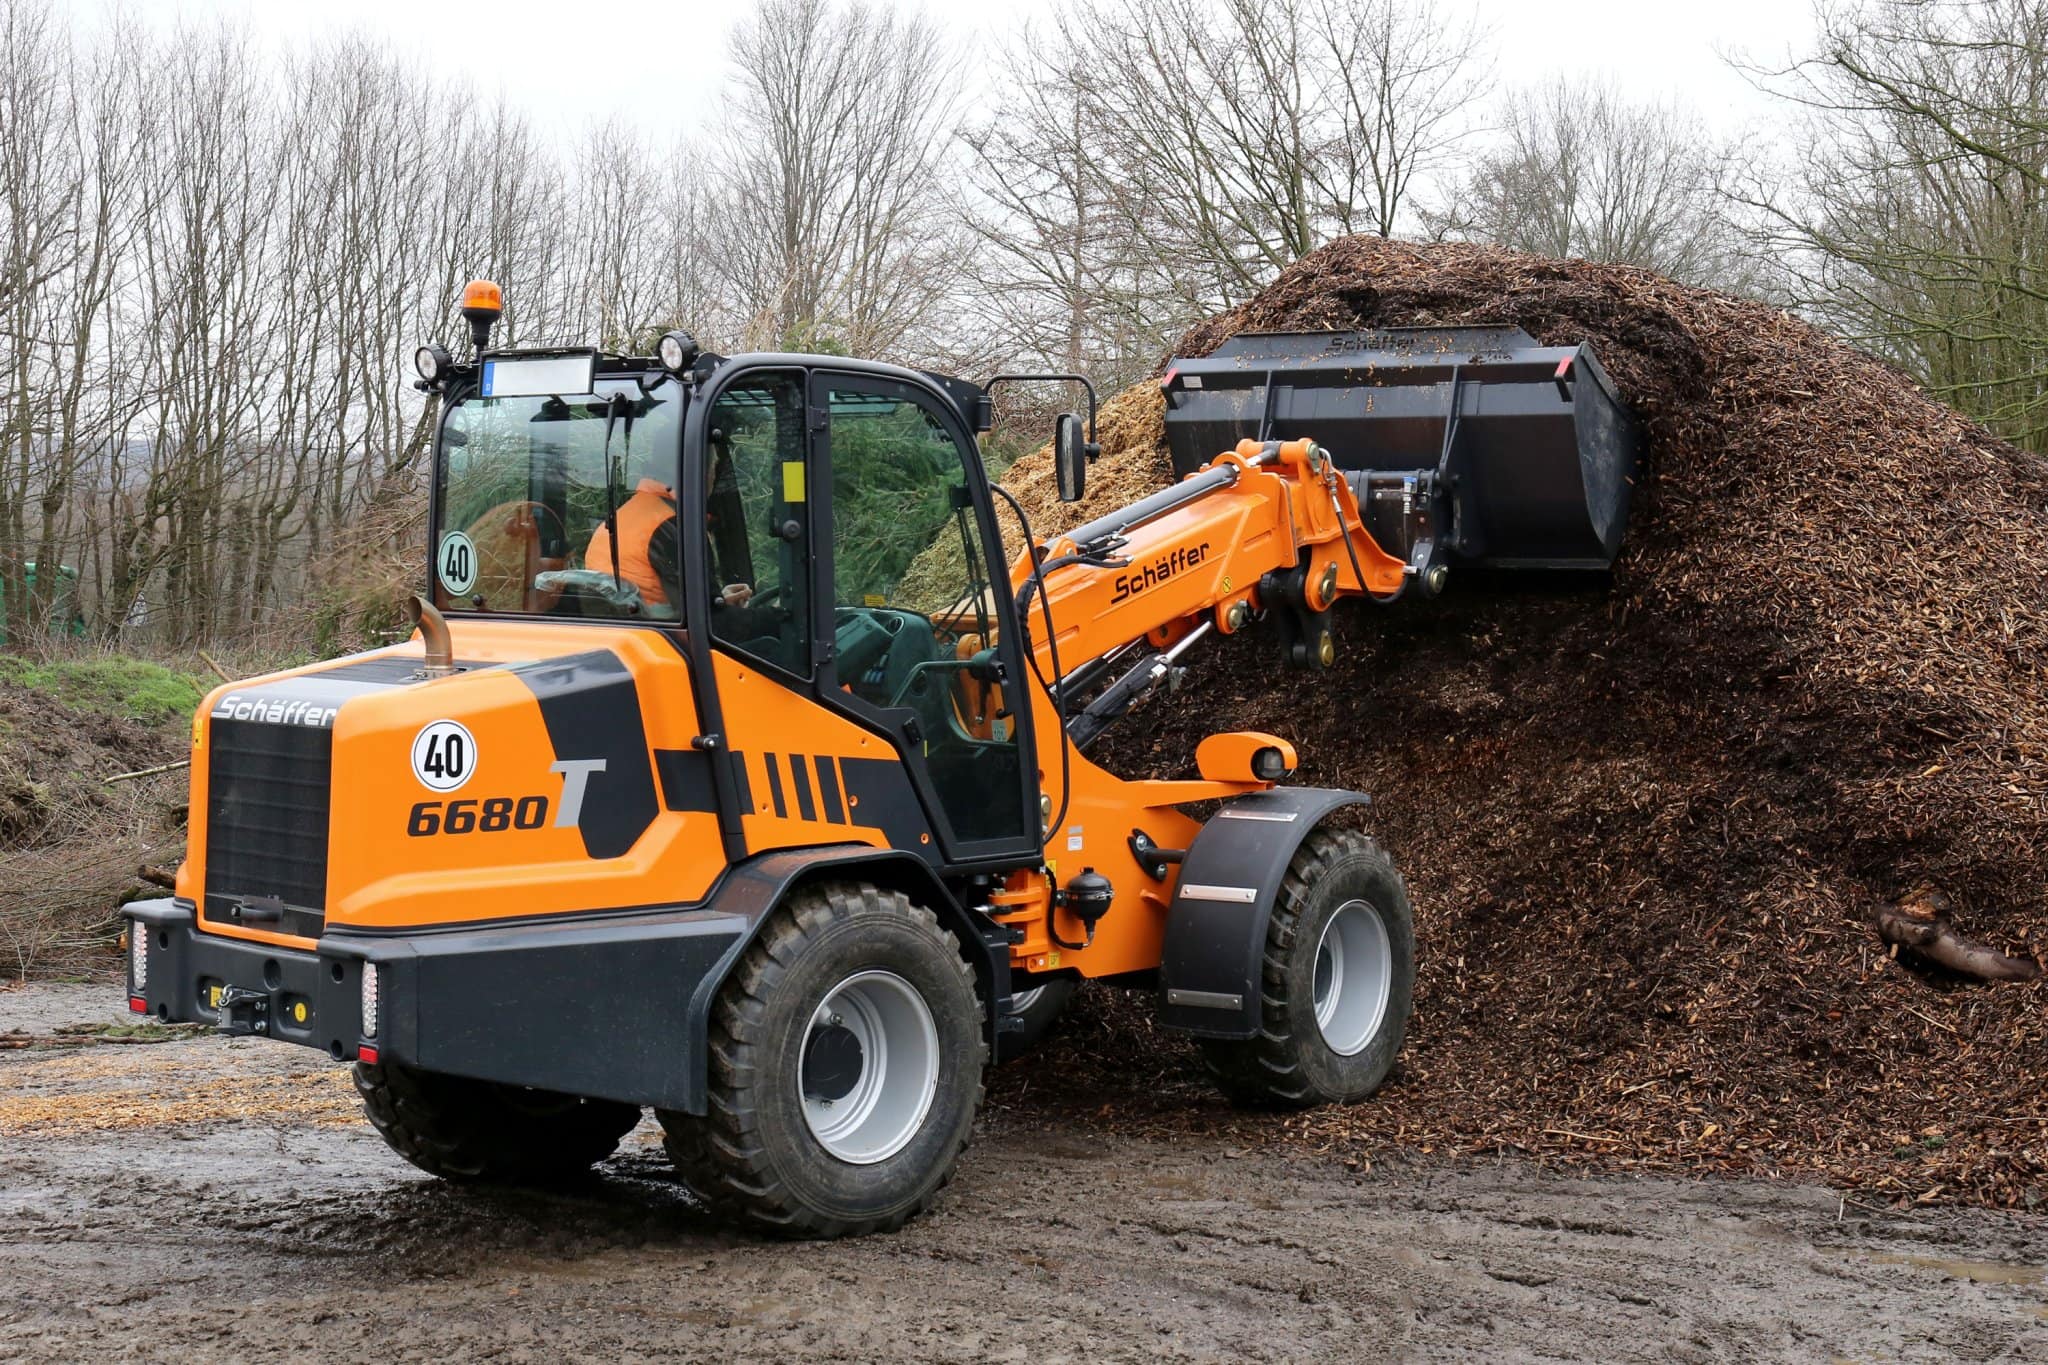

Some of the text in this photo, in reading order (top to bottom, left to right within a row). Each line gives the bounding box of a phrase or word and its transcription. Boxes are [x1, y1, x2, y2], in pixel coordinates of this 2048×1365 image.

[446, 544, 468, 582] 40
[1111, 542, 1210, 605] Schäffer
[210, 695, 337, 726] Schäffer
[424, 733, 463, 778] 40
